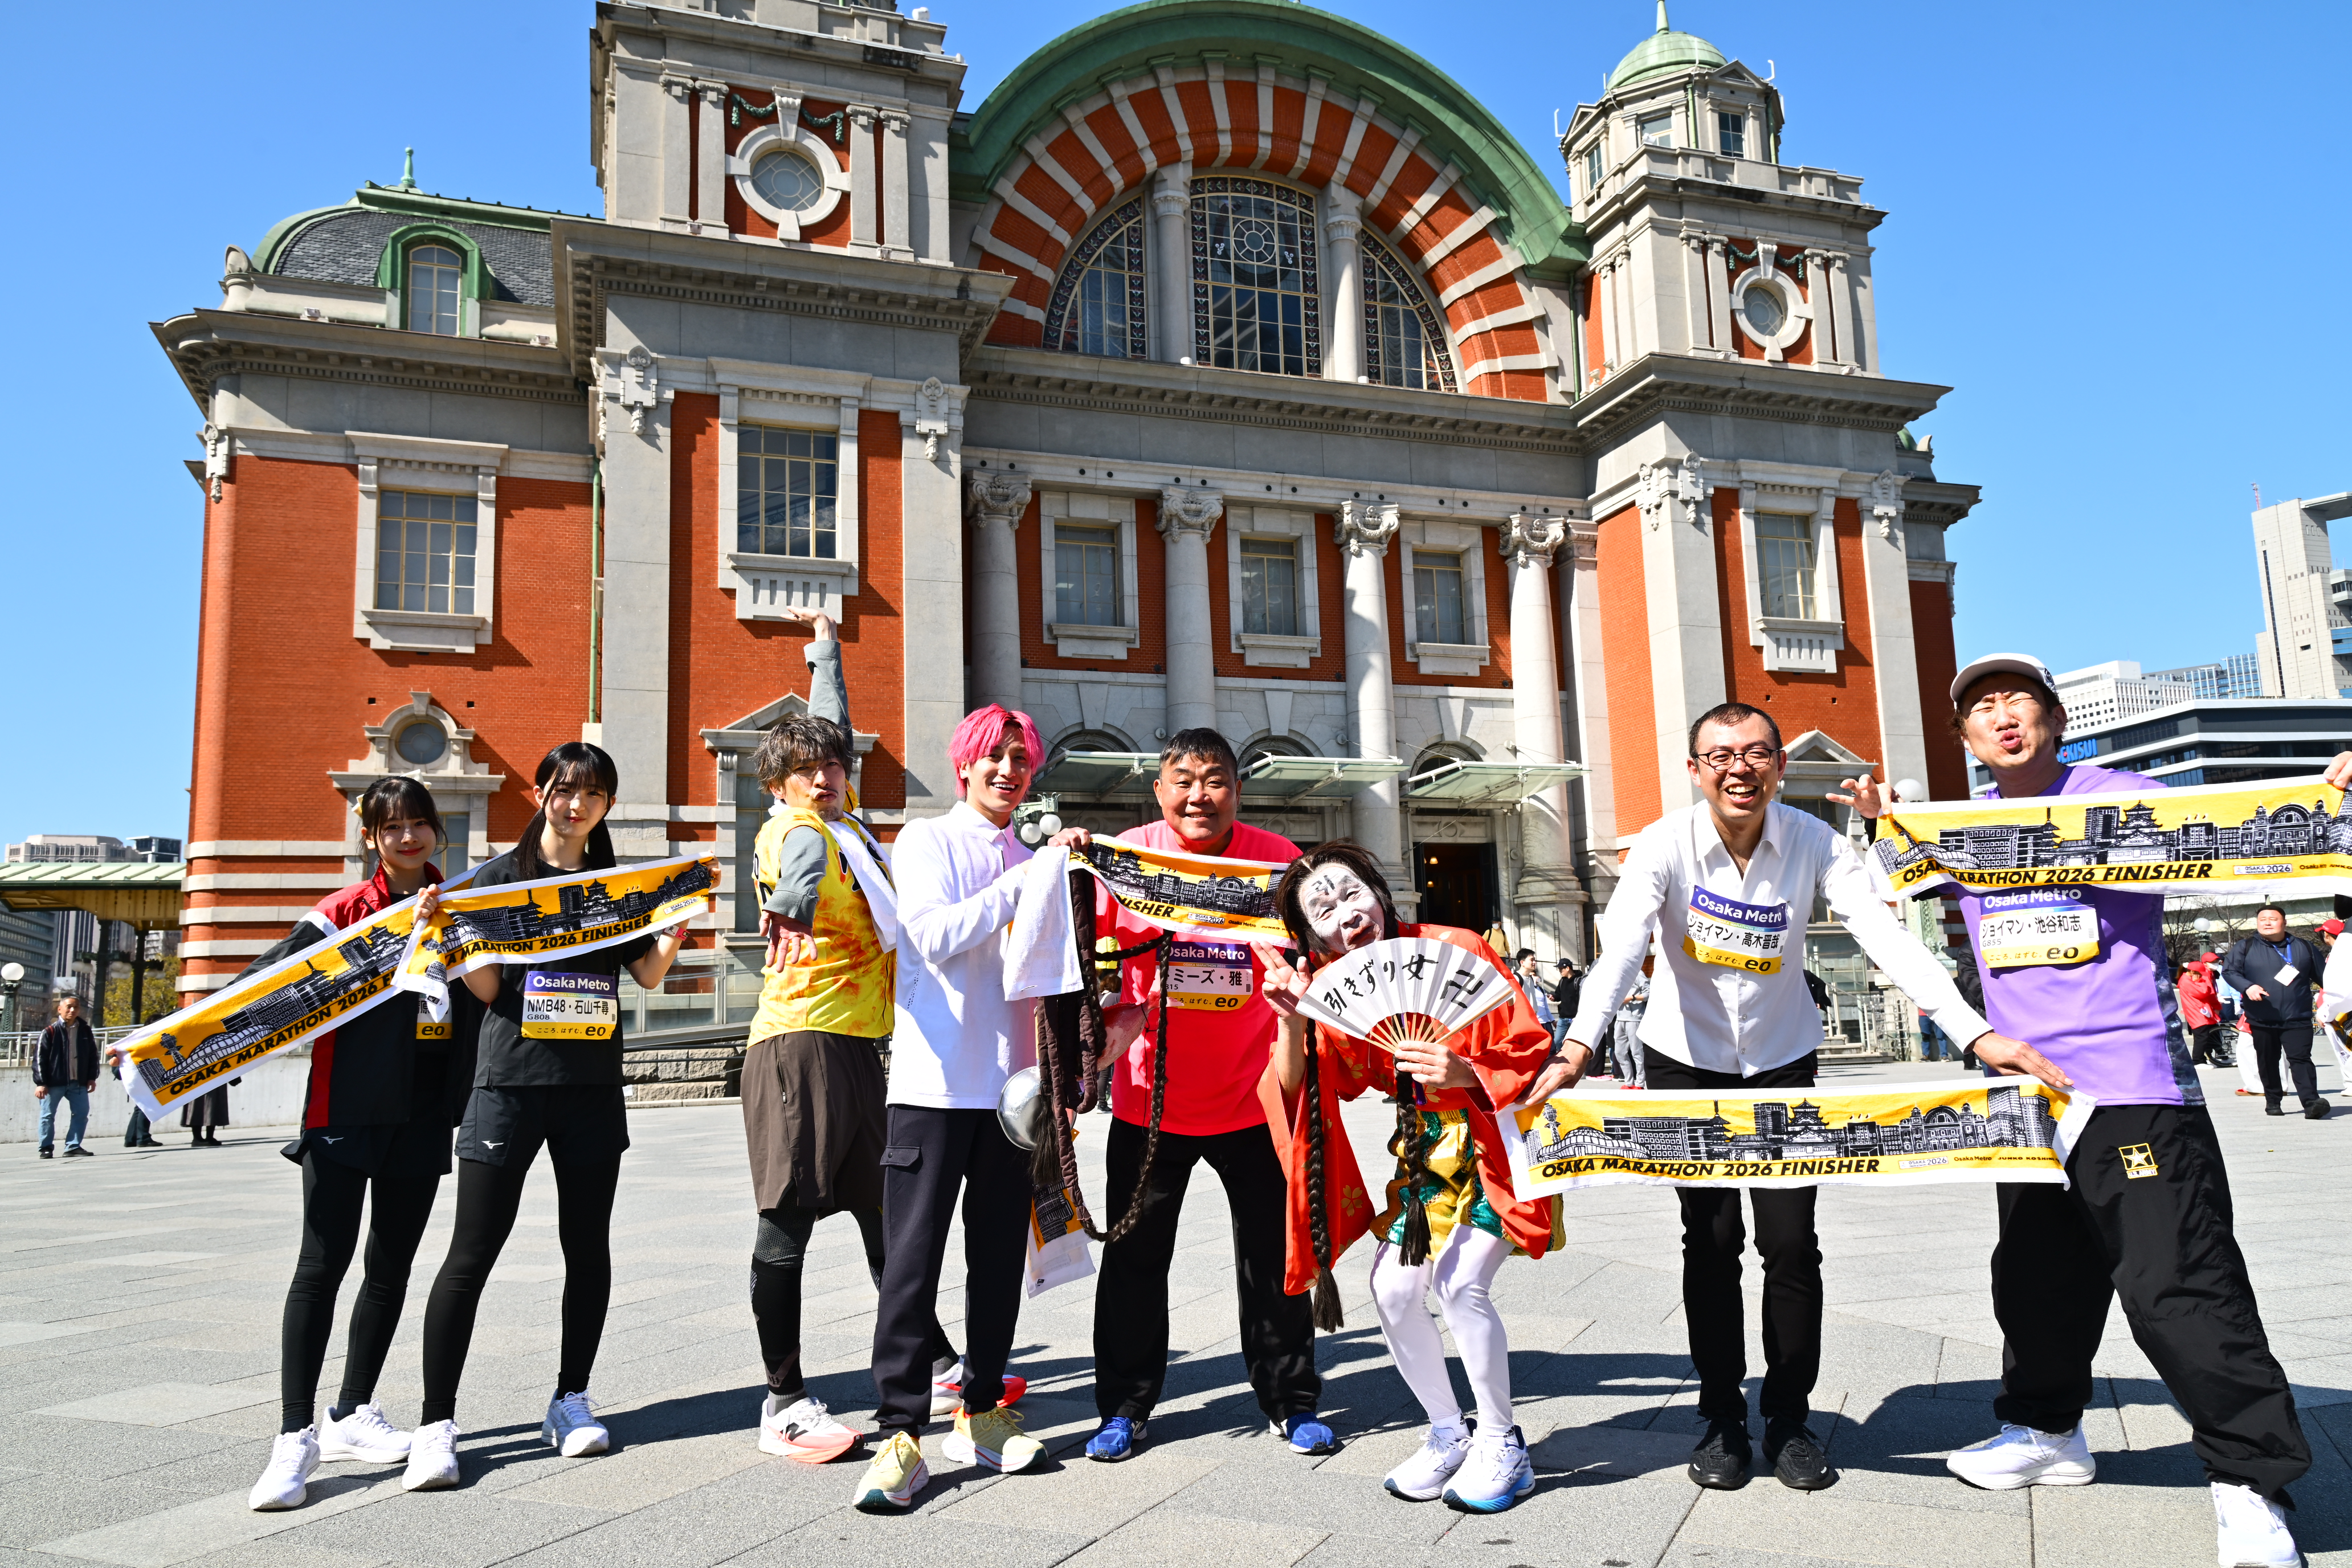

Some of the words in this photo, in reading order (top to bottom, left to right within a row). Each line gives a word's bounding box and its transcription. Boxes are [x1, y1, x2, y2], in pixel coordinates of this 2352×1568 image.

[1903, 860, 1945, 883] OSAK
[2045, 868, 2095, 883] 2026
[2102, 863, 2213, 881] FINISHER
[683, 897, 697, 906] 2026
[1984, 892, 2027, 909] Osaka
[2030, 888, 2081, 903] Metro
[1698, 894, 1742, 918] Osaka
[1745, 909, 1782, 922] Metro
[1982, 913, 2081, 938] ジョイマン・池谷和志
[460, 942, 533, 960] MARATHON
[540, 933, 577, 950] 2026
[581, 914, 652, 942] FINISHER
[1687, 929, 1706, 943] G854
[1982, 938, 2002, 947] G855
[1207, 947, 1246, 960] Metro
[1692, 947, 1741, 965] こころ、はずむ。
[1990, 952, 2042, 961] こころ、はずむ。
[2047, 946, 2079, 959] eo
[1745, 959, 1771, 971] eo
[533, 975, 575, 989] Osaka
[577, 978, 610, 991] Metro
[1167, 969, 1243, 986] ミーズ・雅
[528, 999, 609, 1015] NMB48・石山千尋
[1215, 997, 1238, 1007] eo
[170, 1060, 230, 1095] OSAKA
[236, 1006, 333, 1064] MARATHON
[338, 983, 378, 1013] 2026
[422, 1026, 444, 1036] eo
[585, 1026, 606, 1036] eo
[1542, 1158, 1595, 1177] OSAKA
[1601, 1158, 1714, 1176] MARATHON
[1722, 1163, 1773, 1176] 2026
[1781, 1159, 1880, 1175] FINISHER
